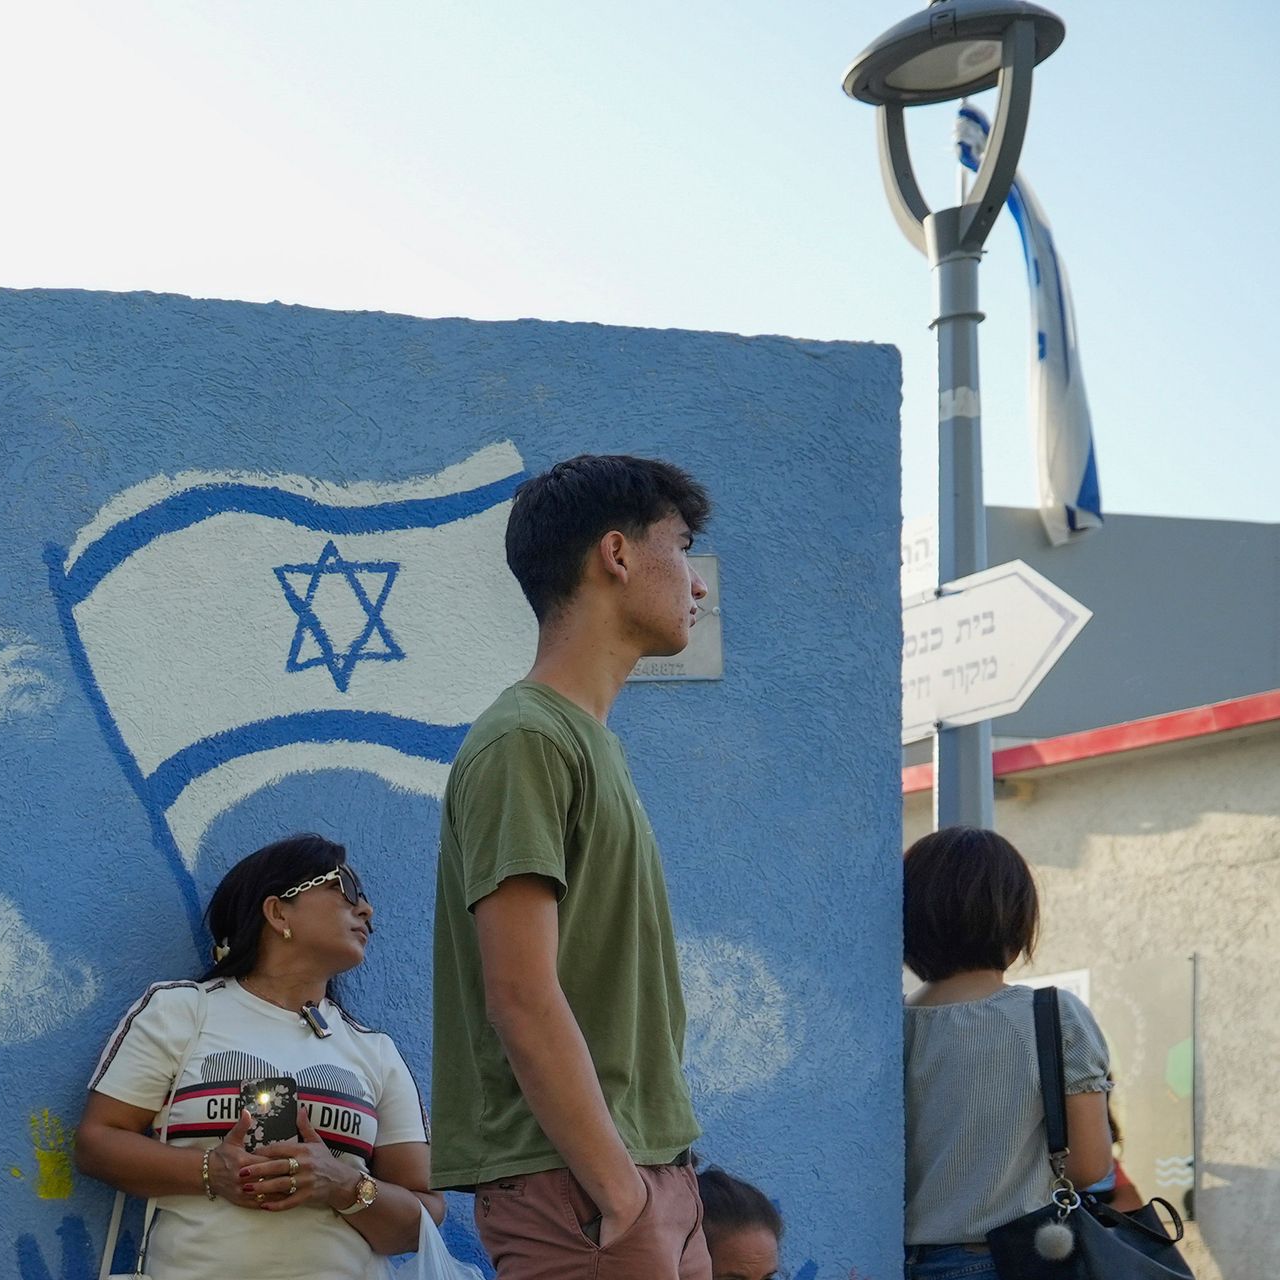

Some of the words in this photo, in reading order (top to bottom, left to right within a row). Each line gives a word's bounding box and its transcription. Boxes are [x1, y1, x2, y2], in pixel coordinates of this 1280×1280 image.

[904, 626, 944, 659] כנס
[954, 609, 996, 645] בית
[941, 654, 998, 696] מקור
[320, 1106, 361, 1136] DIOR
